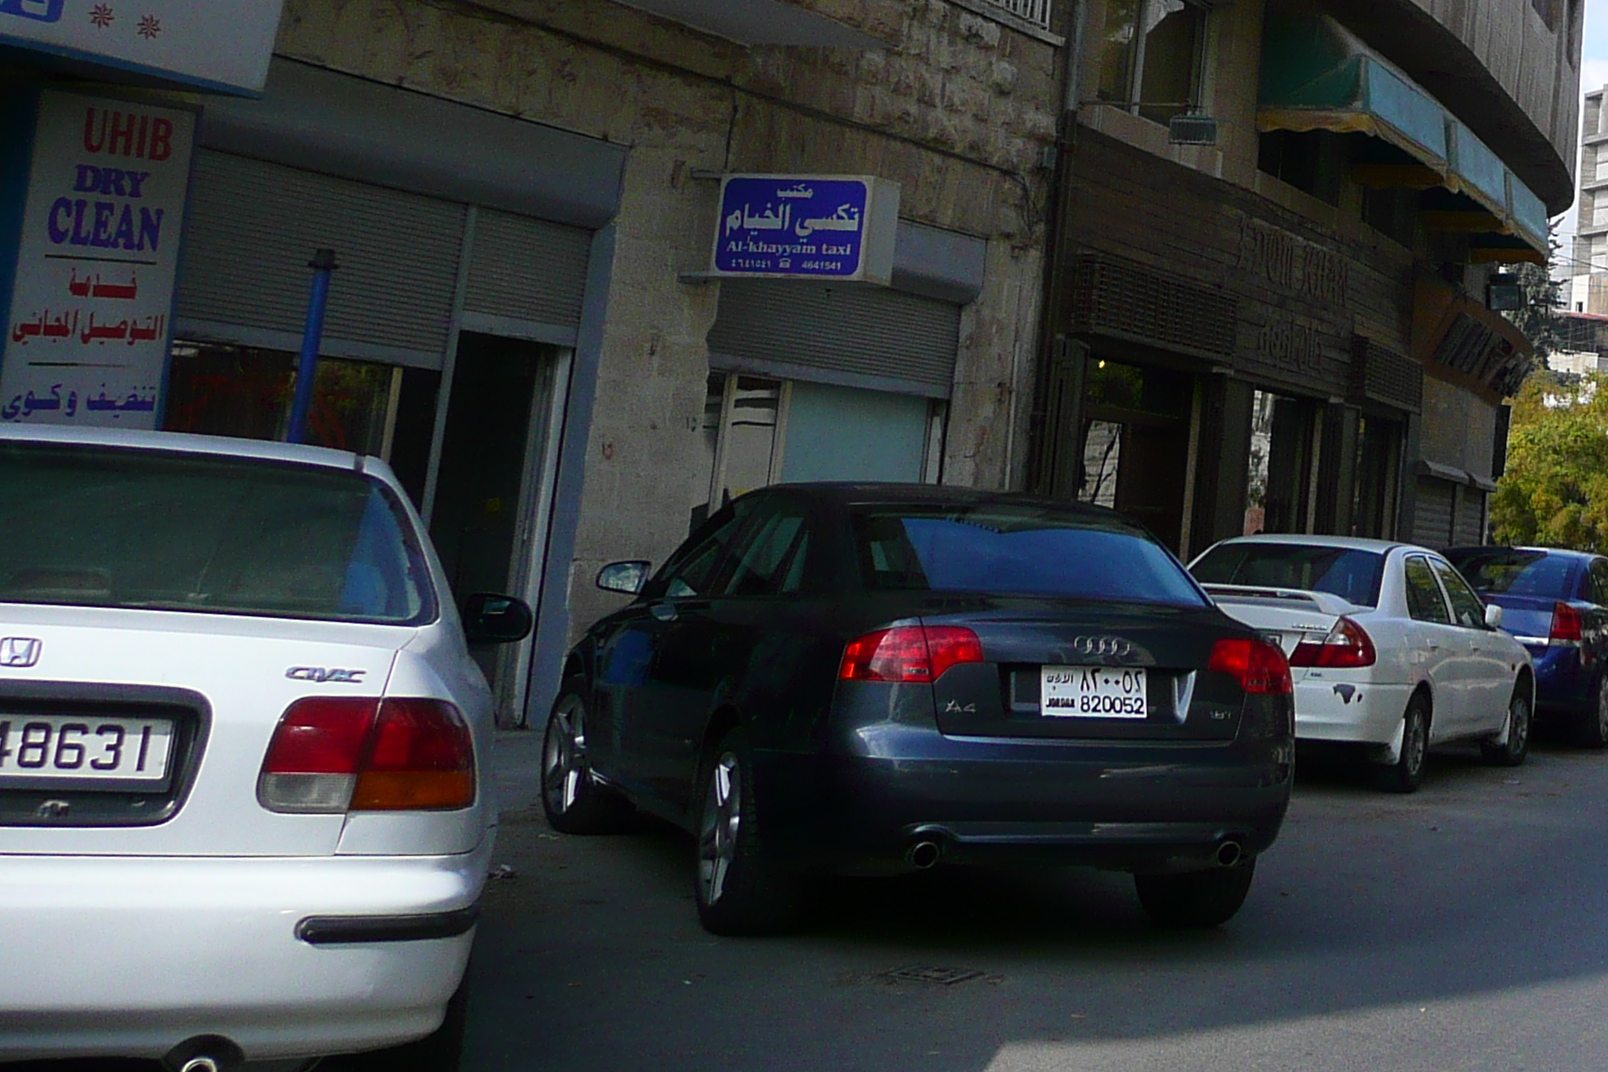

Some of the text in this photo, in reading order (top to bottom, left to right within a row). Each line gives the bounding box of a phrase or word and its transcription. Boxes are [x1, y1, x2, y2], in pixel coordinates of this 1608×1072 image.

[84, 107, 173, 161] UHIB
[73, 164, 150, 198] DRY
[776, 184, 814, 201] مكتب
[48, 196, 164, 252] CLEAN
[725, 202, 860, 243] تكسي الخيام
[821, 242, 852, 256] taxi
[69, 267, 137, 299] خدمة
[12, 309, 164, 346] التوصيل المجاني
[1080, 695, 1144, 714] 820052
